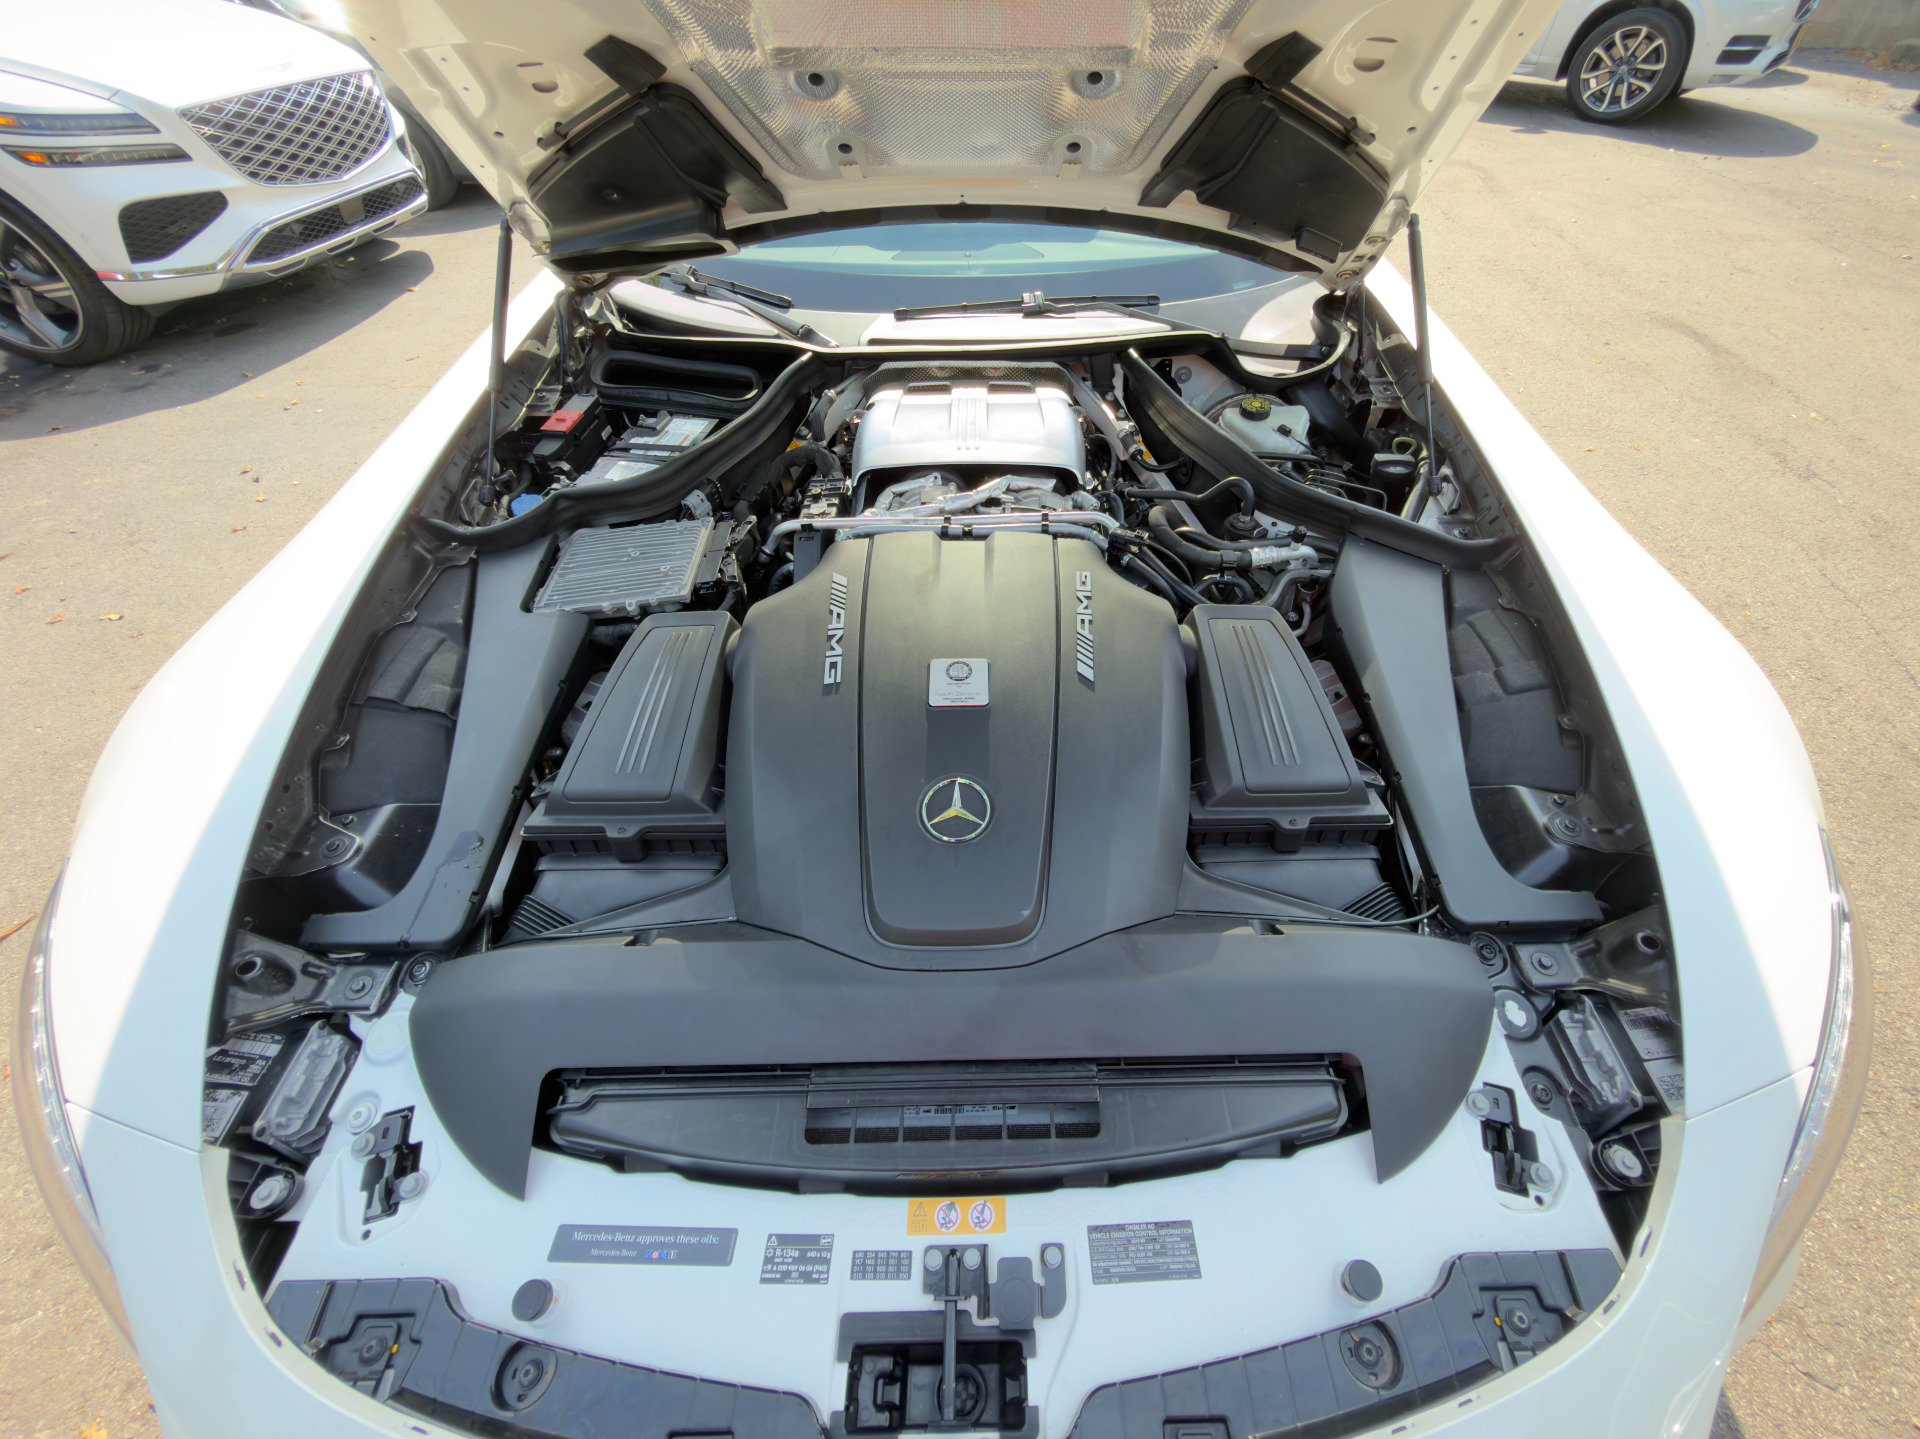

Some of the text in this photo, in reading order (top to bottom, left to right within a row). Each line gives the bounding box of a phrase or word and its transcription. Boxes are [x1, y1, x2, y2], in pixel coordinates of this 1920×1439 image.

[1076, 570, 1094, 638] AMG
[824, 604, 846, 685] AMG
[572, 1231, 719, 1245] Mercedes-Benz approves these oils:
[590, 1248, 637, 1257] Mercedes-Benz
[775, 1249, 799, 1258] R-134a
